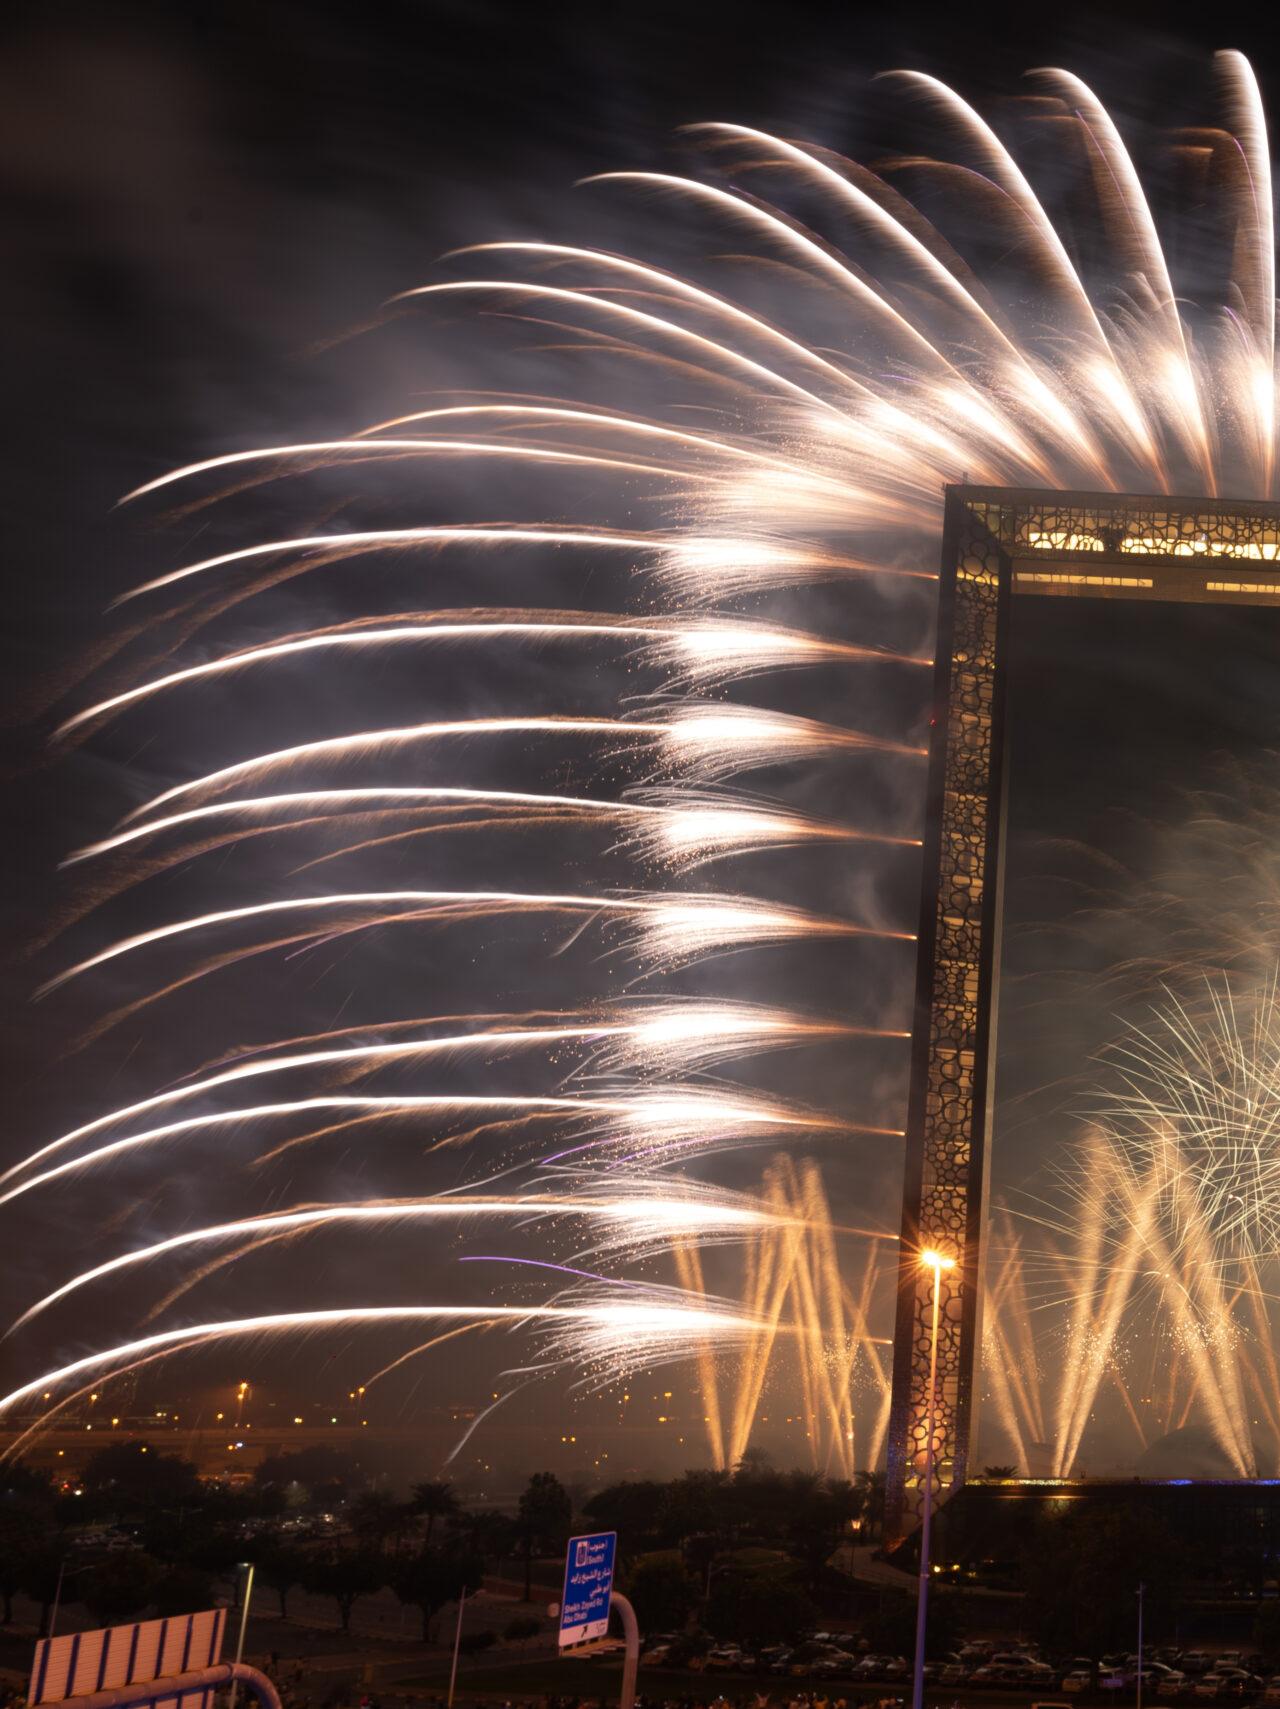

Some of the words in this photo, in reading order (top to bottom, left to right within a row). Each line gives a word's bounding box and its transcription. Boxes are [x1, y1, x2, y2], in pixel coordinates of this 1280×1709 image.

[564, 1603, 581, 1614] Sheikh
[582, 1600, 596, 1610] Zayed
[574, 1612, 588, 1621] Dhabi
